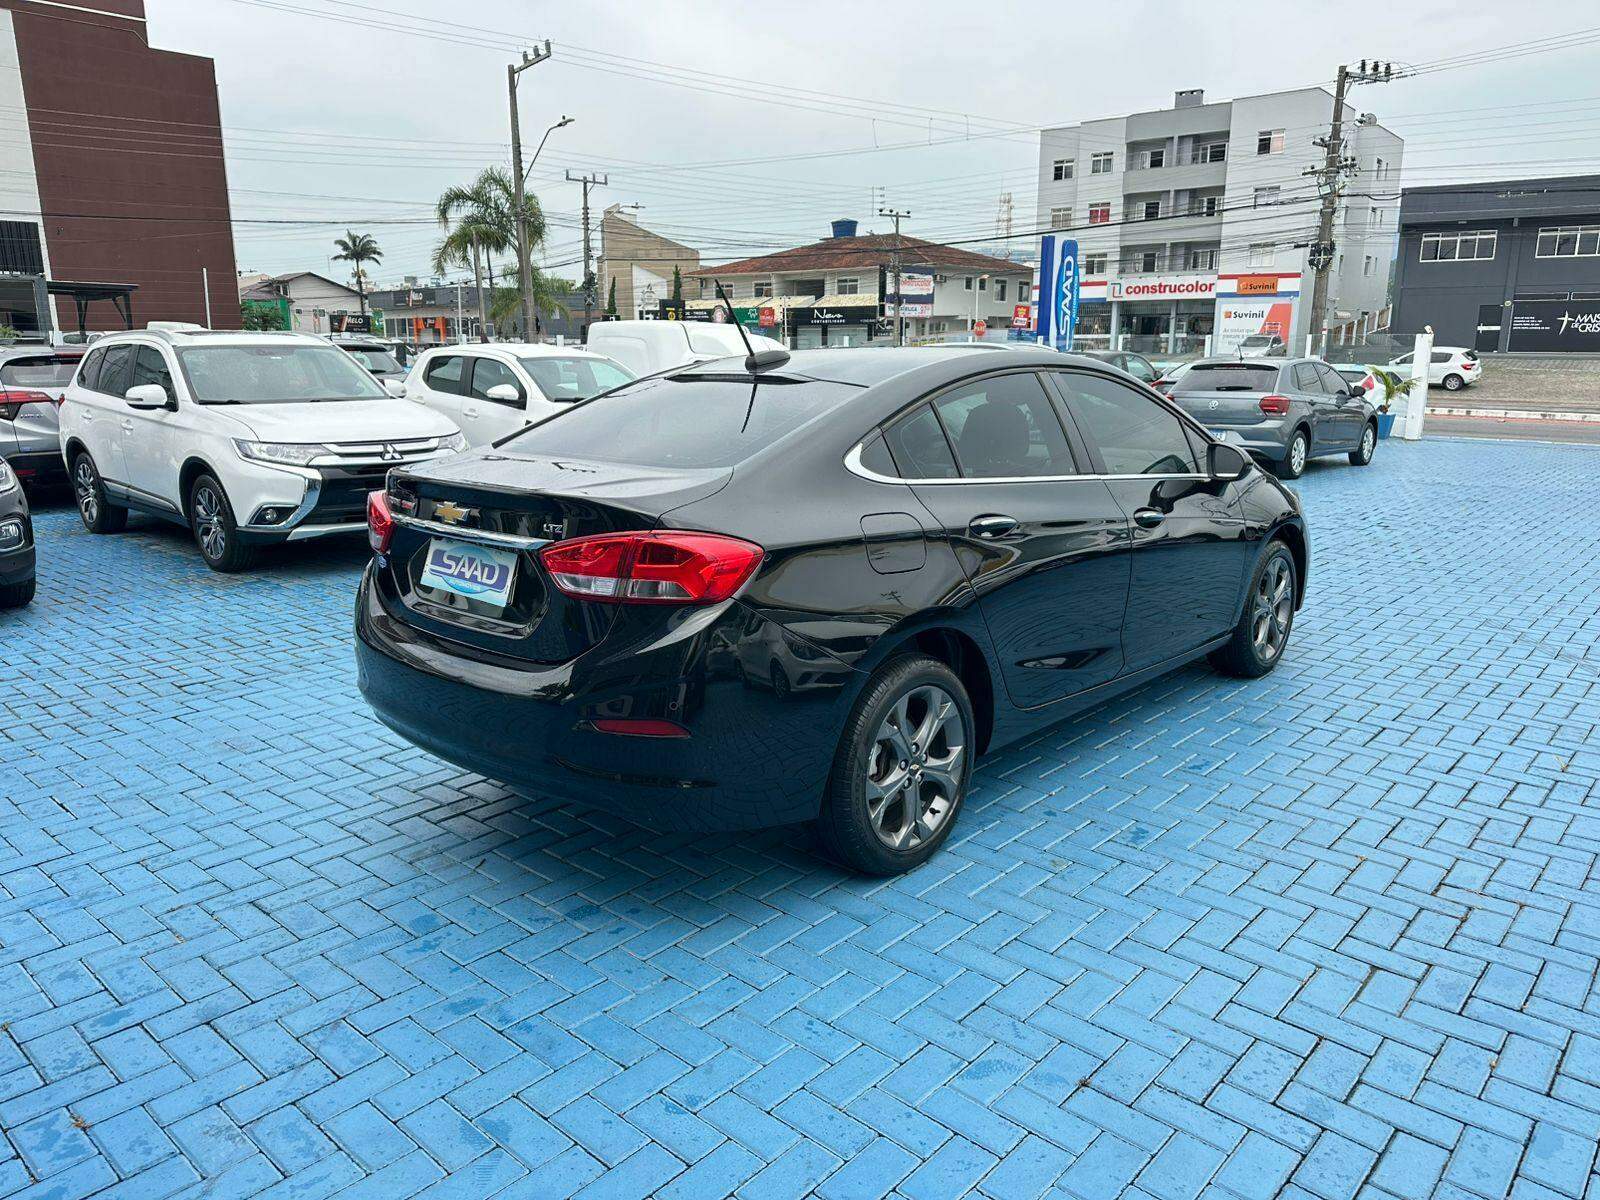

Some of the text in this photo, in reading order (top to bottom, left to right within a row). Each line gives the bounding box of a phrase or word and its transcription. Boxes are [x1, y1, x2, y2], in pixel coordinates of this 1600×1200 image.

[1125, 280, 1215, 295] construcolor
[1060, 255, 1074, 350] SAAD
[1233, 310, 1264, 318] Suvinil
[1575, 313, 1600, 323] MAIS
[543, 523, 563, 533] LTZ
[431, 551, 500, 585] SAAD
